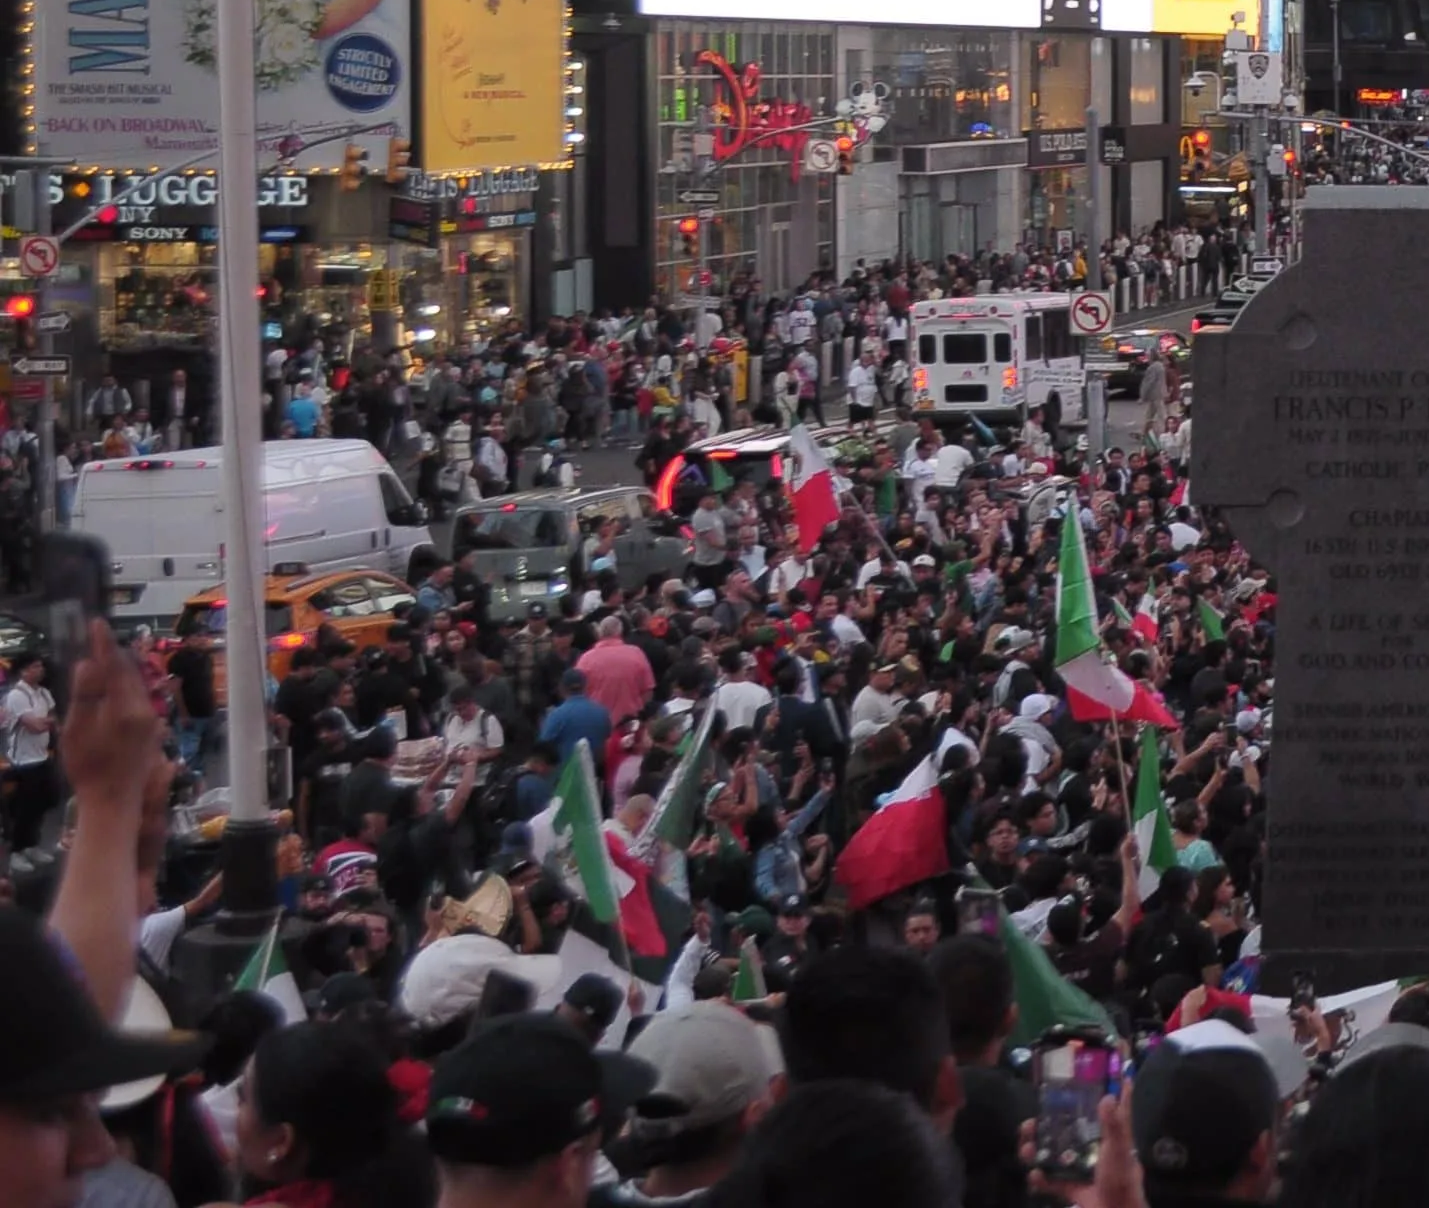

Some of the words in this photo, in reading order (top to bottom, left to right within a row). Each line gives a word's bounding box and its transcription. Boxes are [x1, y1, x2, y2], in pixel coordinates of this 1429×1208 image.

[336, 47, 394, 69] STRICTLY
[336, 62, 389, 83] LIMITED
[48, 117, 89, 135] BACK
[92, 117, 116, 135] ON
[98, 174, 308, 207] LUGGGE
[129, 227, 189, 240] SONY
[1273, 395, 1389, 422] FRANCIS
[1304, 460, 1400, 479] CATHOLIC
[1330, 613, 1370, 630] LIFE
